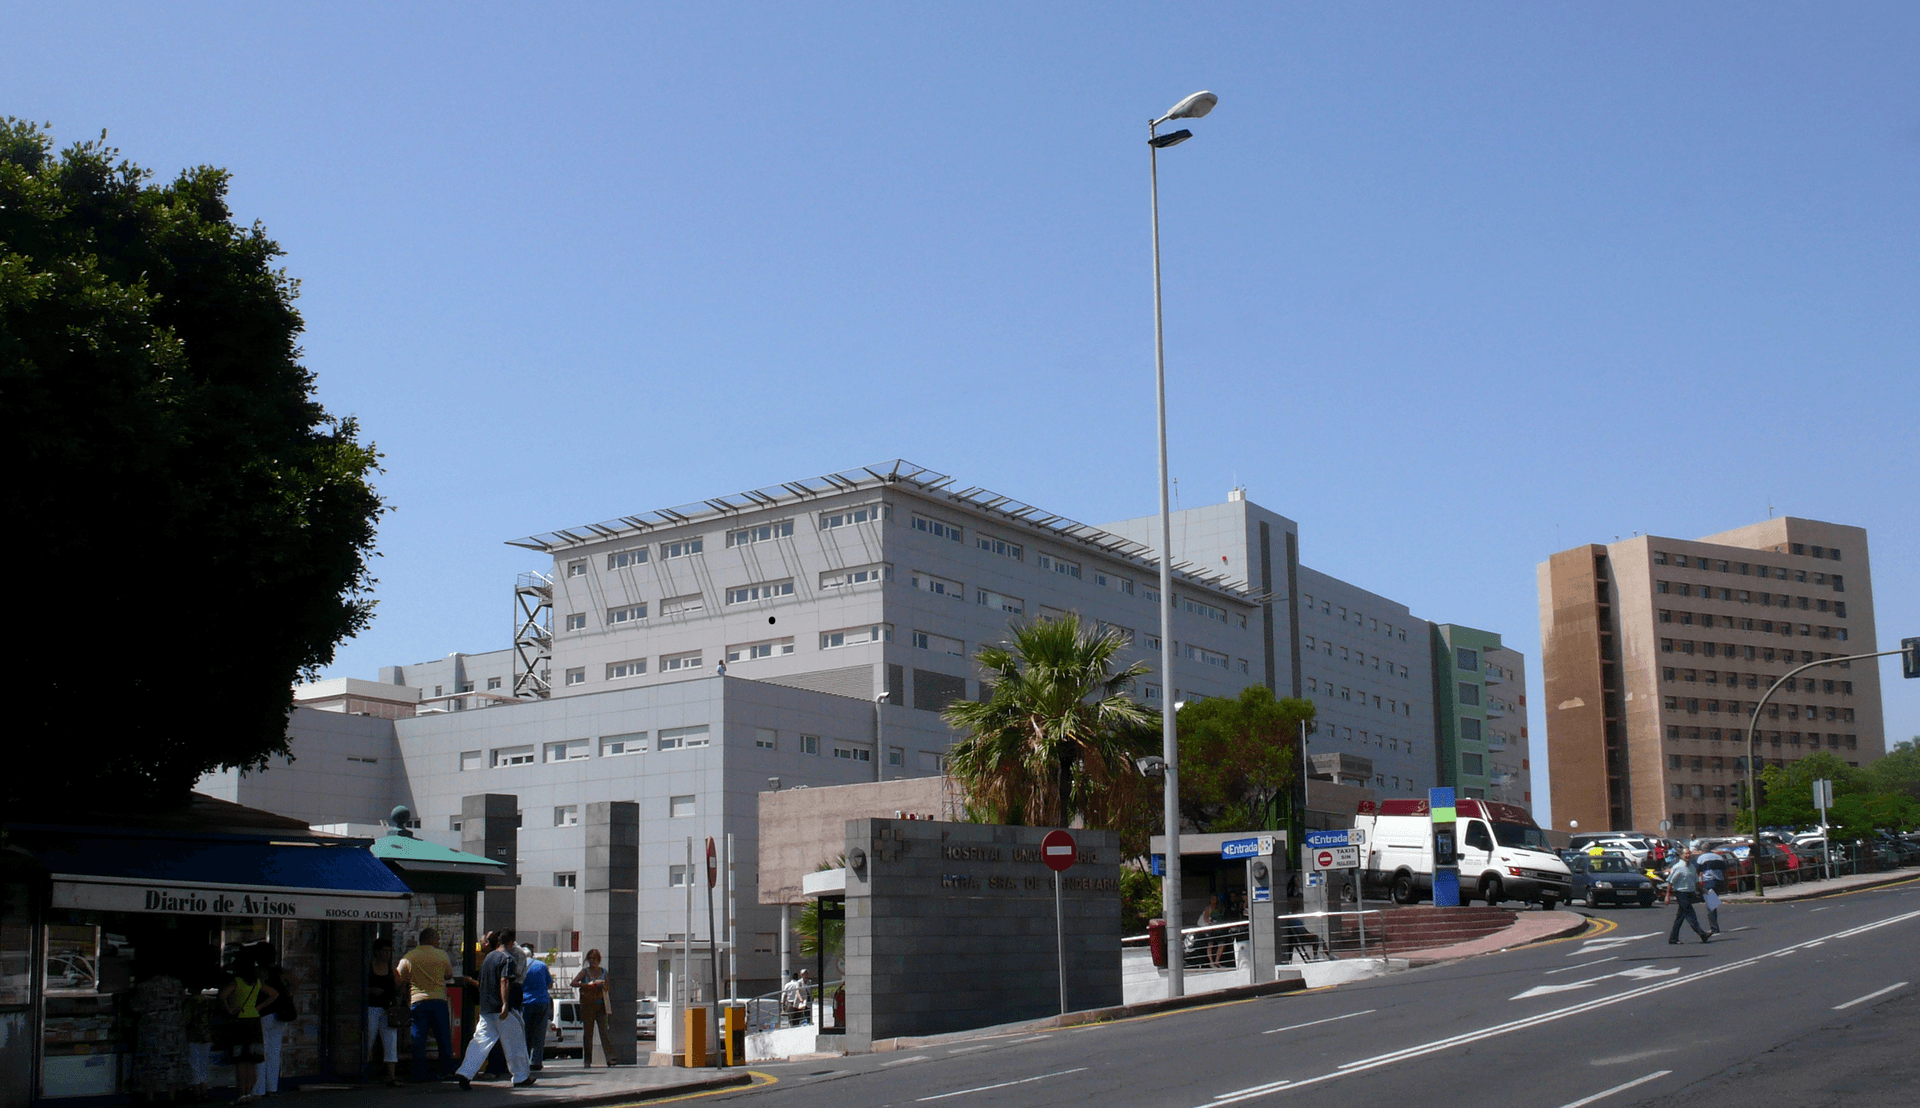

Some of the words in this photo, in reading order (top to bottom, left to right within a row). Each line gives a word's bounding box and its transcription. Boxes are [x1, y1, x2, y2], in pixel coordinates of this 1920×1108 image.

[1314, 833, 1348, 845] Entrada
[1229, 842, 1258, 855] Entrada
[1024, 877, 1040, 890] DE
[144, 890, 207, 913] Diario
[213, 894, 234, 913] de
[240, 894, 296, 916] Avisos
[326, 908, 359, 918] KIOSCO
[364, 910, 403, 920] AGUSTIN
